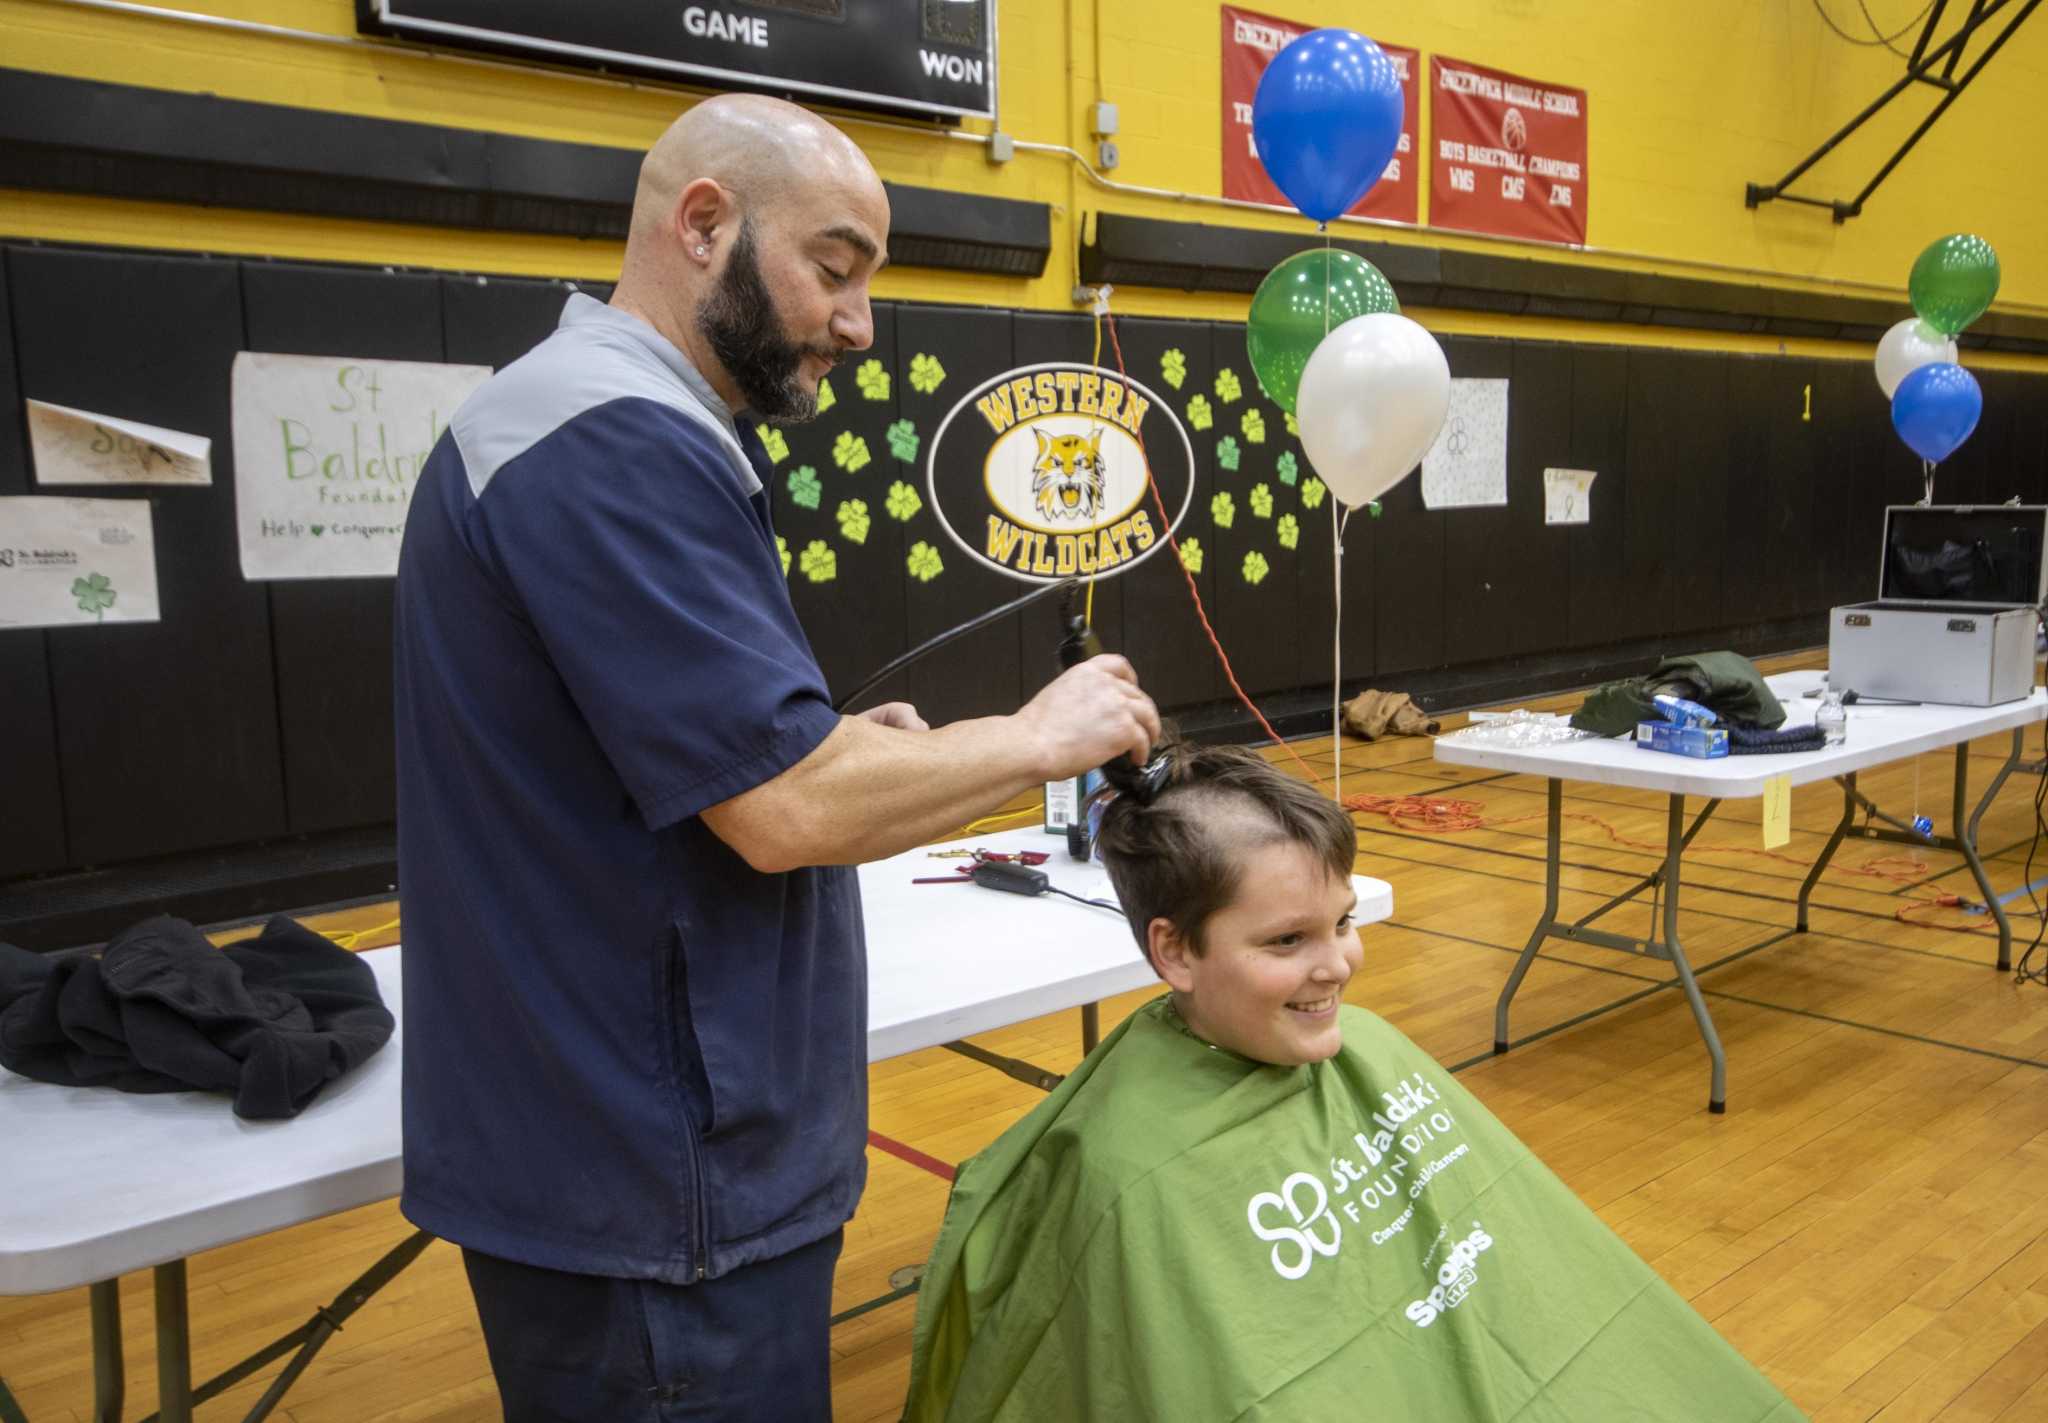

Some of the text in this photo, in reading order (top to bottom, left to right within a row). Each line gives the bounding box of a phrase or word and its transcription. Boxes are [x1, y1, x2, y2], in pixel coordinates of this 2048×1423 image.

[683, 6, 768, 47] GAME
[919, 49, 983, 85] WON
[1543, 90, 1580, 118] SCHOOL
[1440, 139, 1465, 161] BOYS
[1467, 143, 1526, 173] BASKETBALL
[1528, 155, 1580, 182] CHAMPIONS
[1449, 165, 1475, 192] WMS
[1502, 175, 1525, 202] CMS
[330, 366, 382, 412] St
[976, 371, 1149, 435] WESTERN
[261, 519, 304, 538] Help
[986, 510, 1156, 576] WILDCATS
[1330, 1156, 1368, 1194] St.
[1371, 1201, 1415, 1245] Conquer
